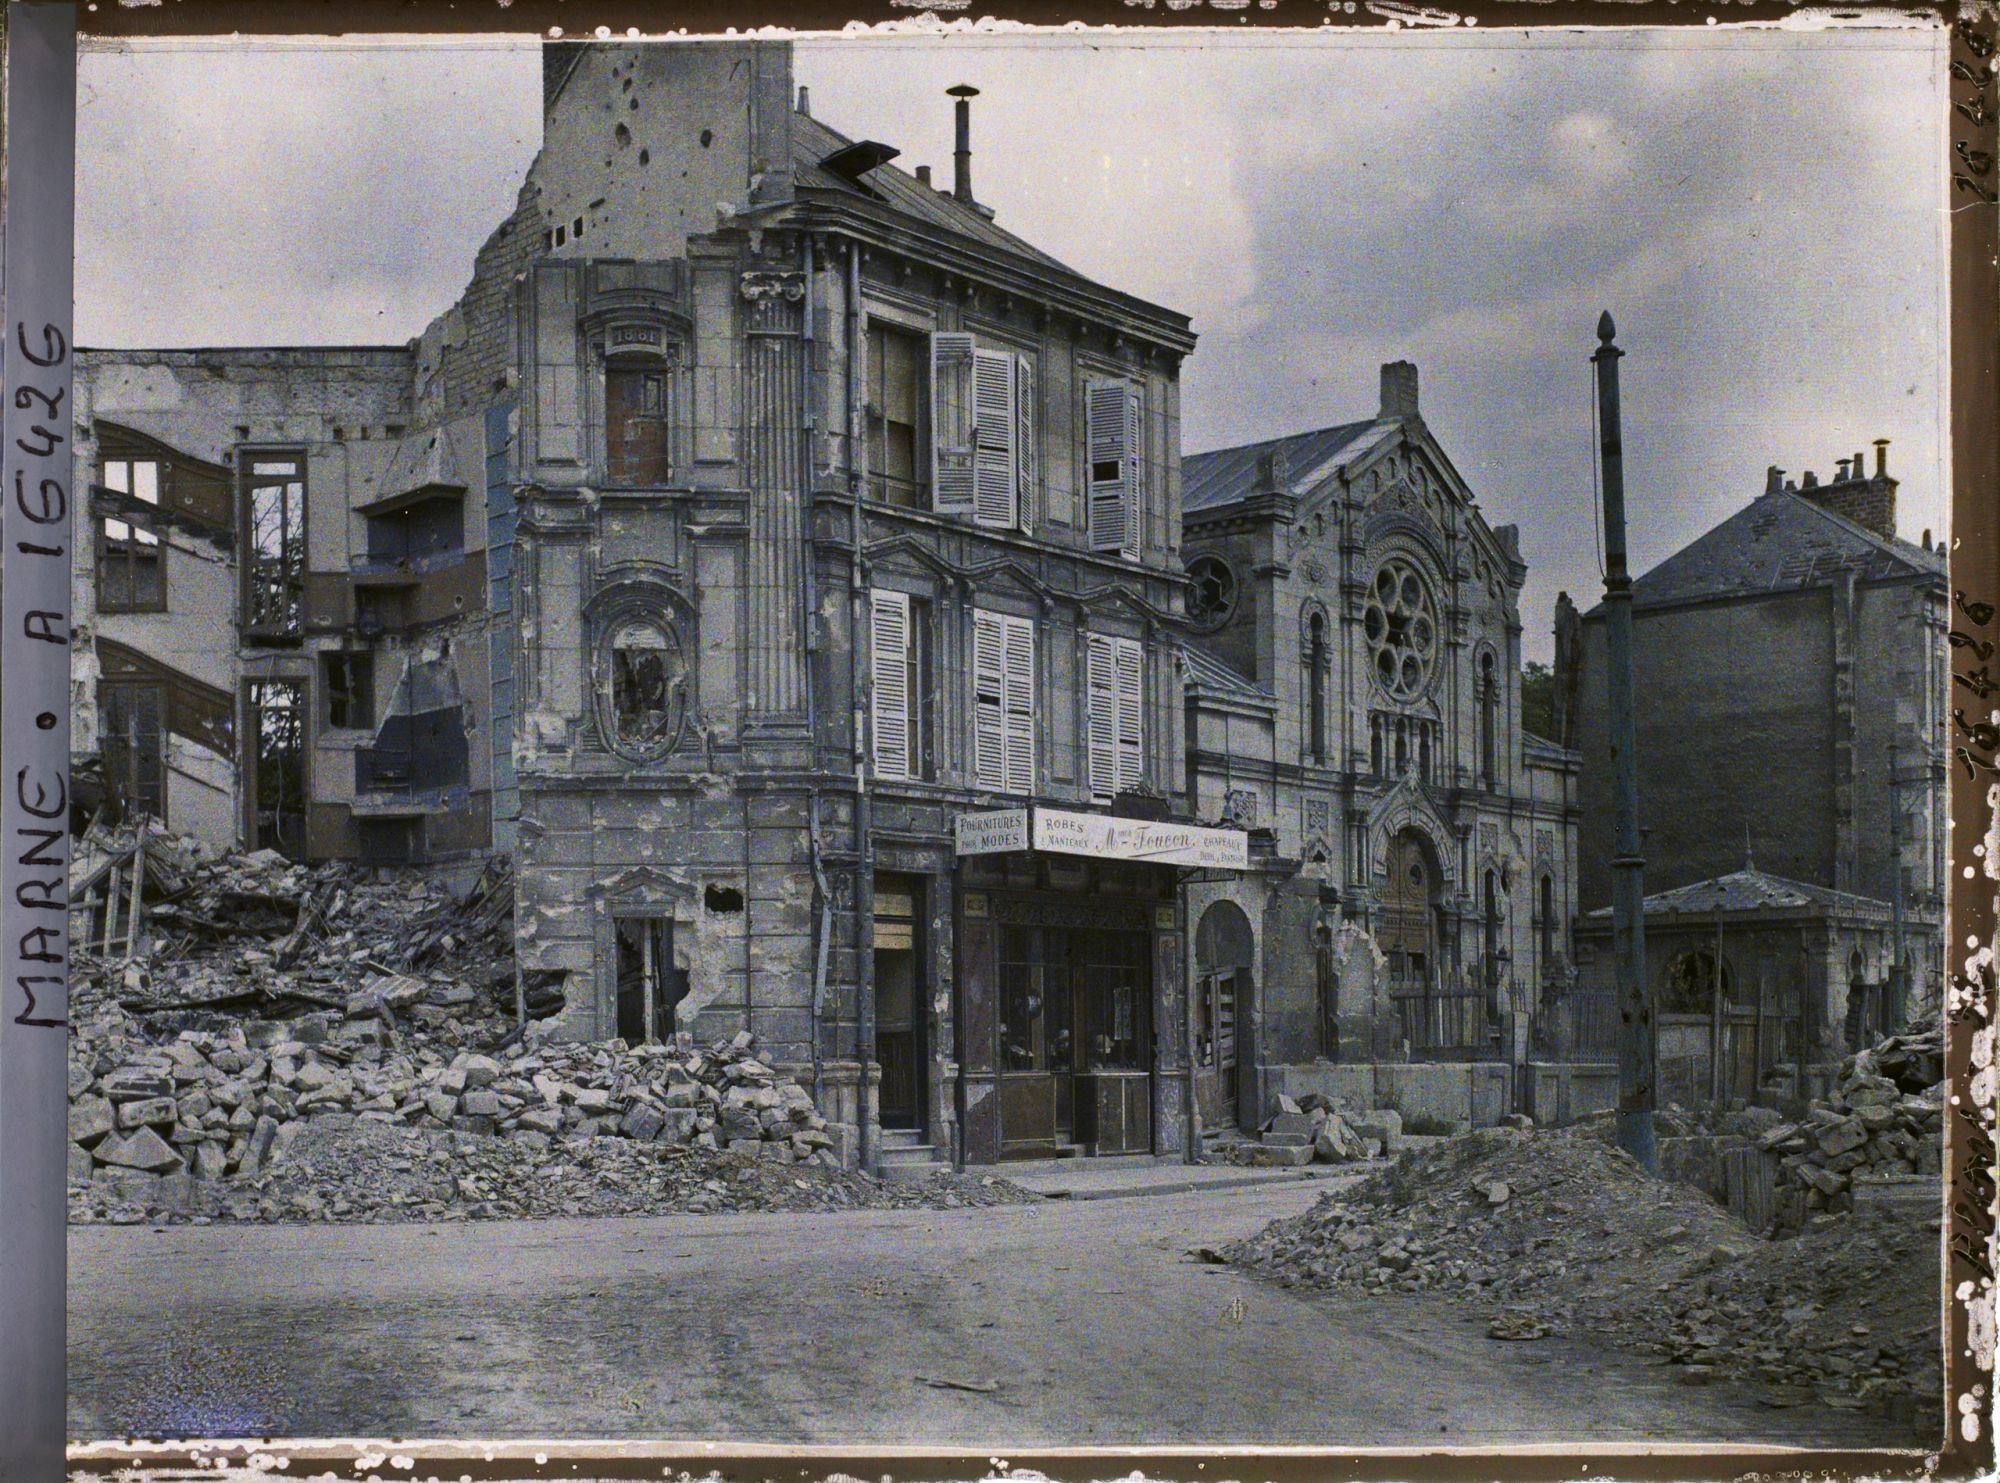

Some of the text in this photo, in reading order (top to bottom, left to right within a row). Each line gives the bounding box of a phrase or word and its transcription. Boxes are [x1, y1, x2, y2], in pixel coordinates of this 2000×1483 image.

[24, 611, 67, 644] A
[960, 815, 1022, 833] FOURNITURES
[1046, 818, 1084, 834] ROBES
[981, 833, 1019, 849] MODES
[14, 765, 66, 1028] MARNE
